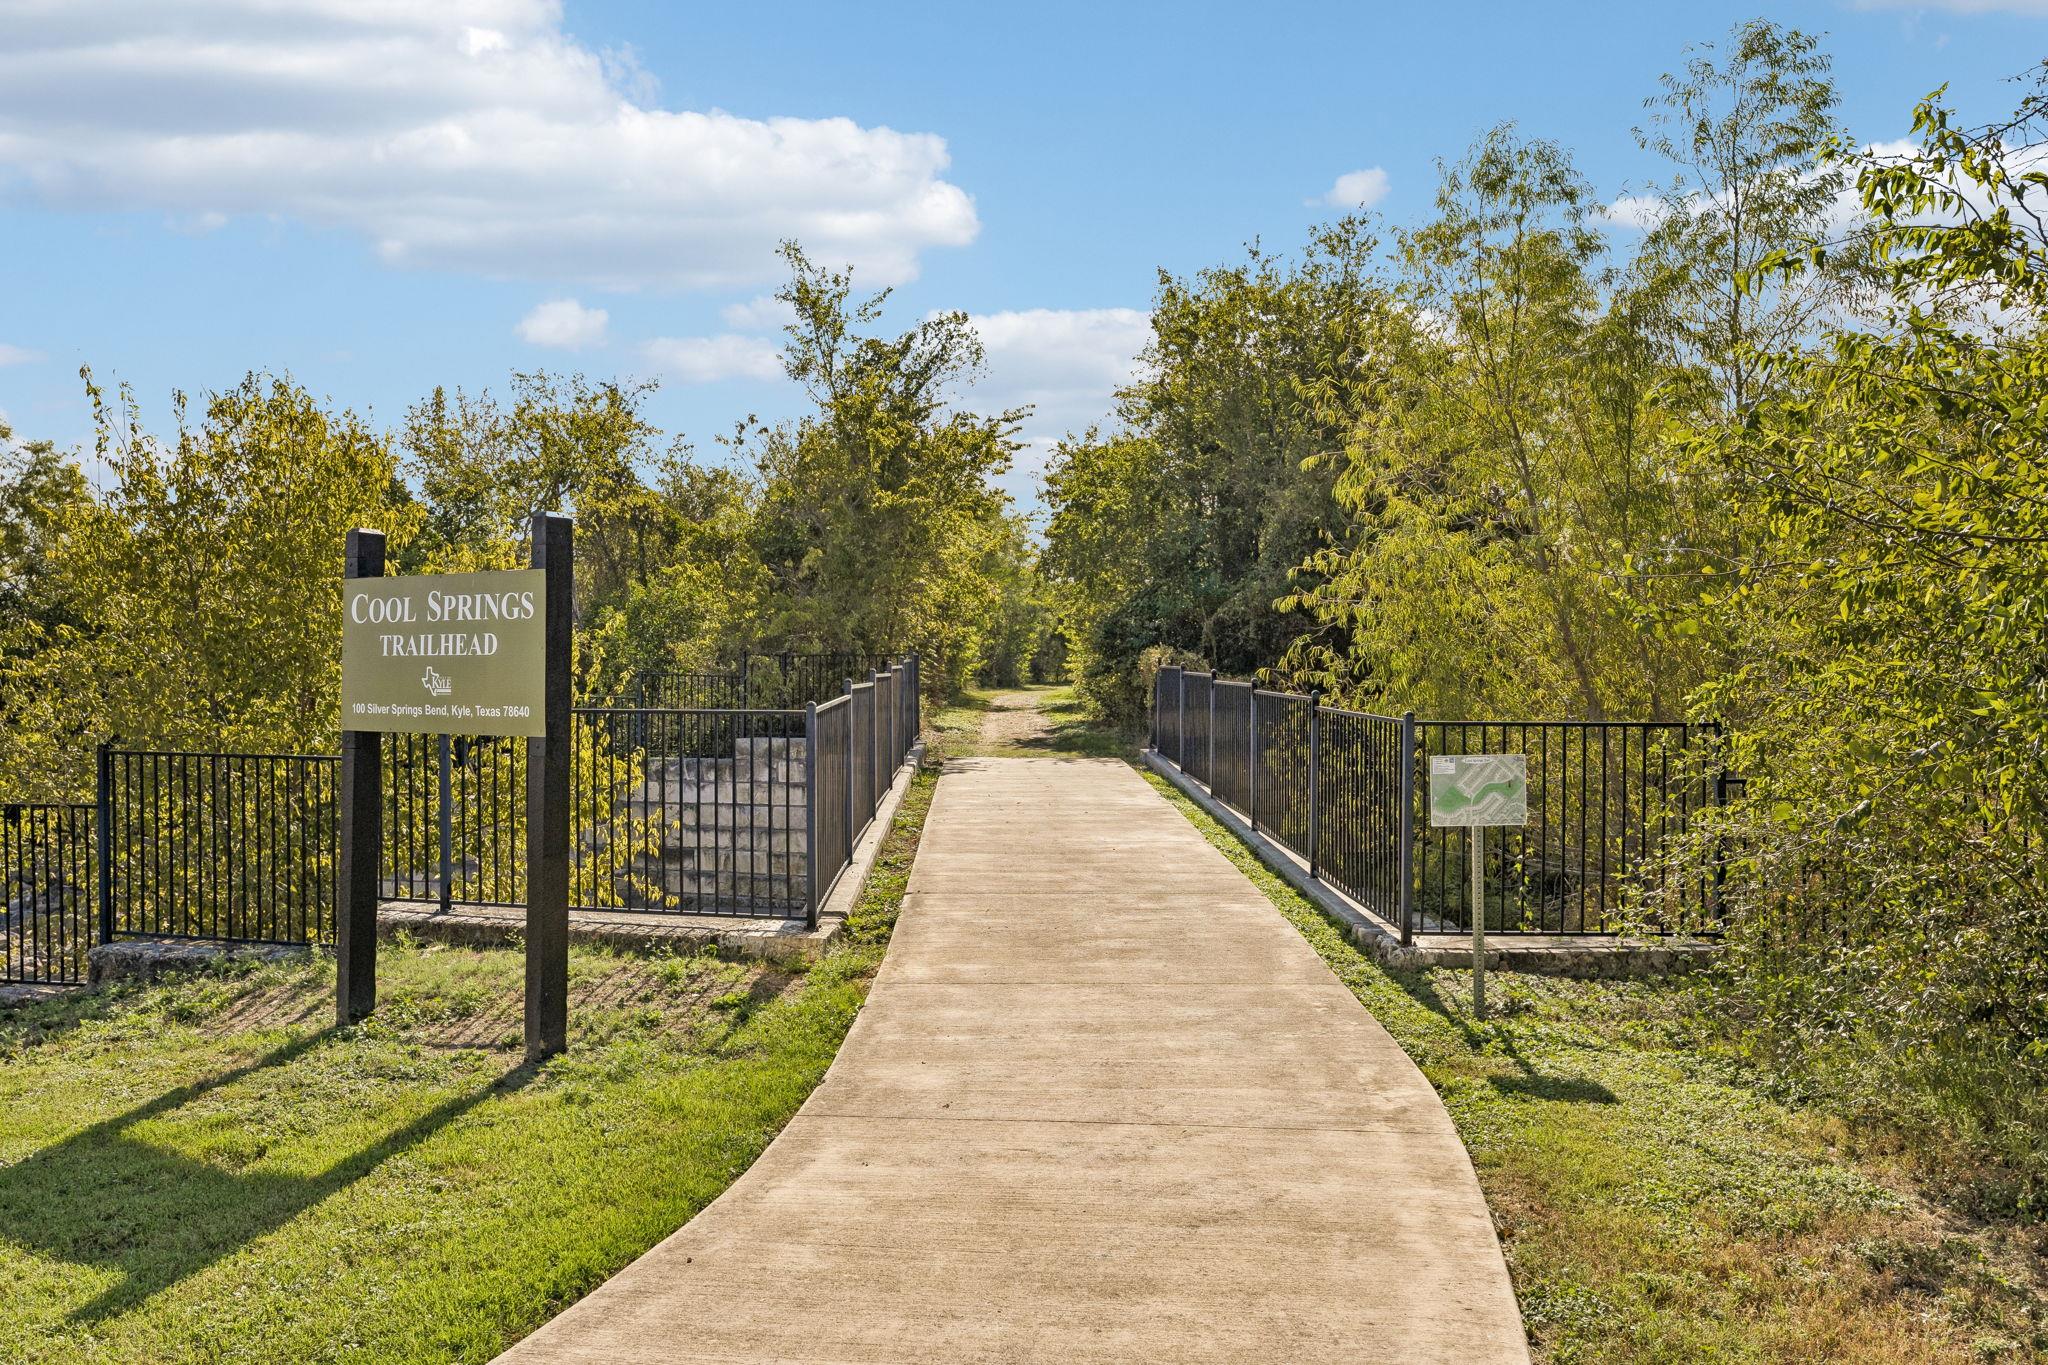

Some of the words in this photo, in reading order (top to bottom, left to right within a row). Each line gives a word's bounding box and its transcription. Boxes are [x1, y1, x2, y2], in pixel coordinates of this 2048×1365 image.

[351, 593, 416, 624] COOL
[427, 591, 535, 622] SPRINGS
[380, 633, 498, 656] TRAILHEAD
[432, 676, 452, 689] KYLE
[352, 703, 366, 714] 100
[367, 704, 390, 715] Silver
[392, 704, 423, 717] Springs
[425, 705, 450, 717] Bend,
[452, 705, 474, 718] Kyle,
[475, 705, 501, 717] Texas
[503, 706, 530, 717] 78640
